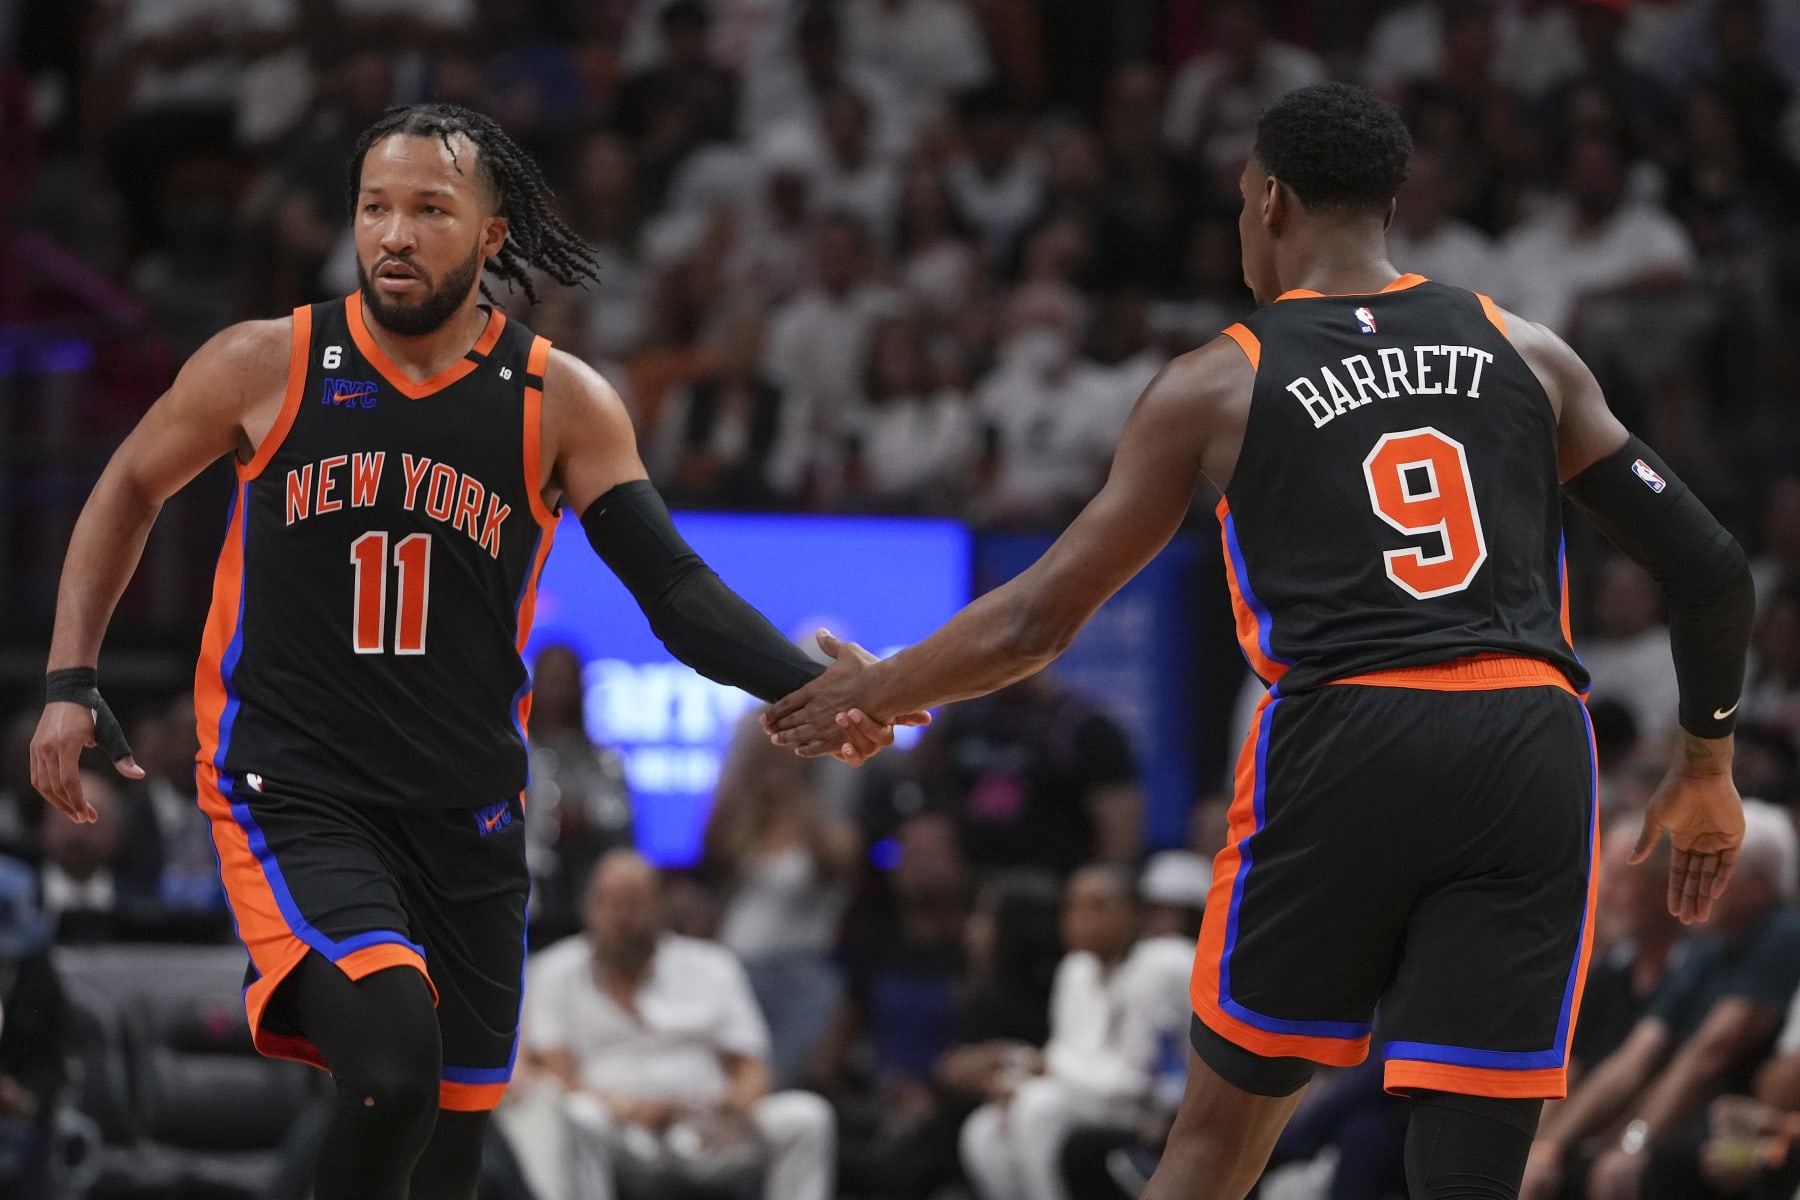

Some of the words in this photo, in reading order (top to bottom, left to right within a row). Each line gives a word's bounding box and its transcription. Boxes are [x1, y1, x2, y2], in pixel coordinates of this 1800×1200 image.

[322, 345, 343, 370] 6
[322, 377, 379, 409] NYC
[1285, 344, 1494, 429] BARRETT
[286, 451, 386, 527] NEW
[402, 453, 512, 560] YORK
[1362, 426, 1488, 600] 9
[350, 530, 432, 655] 11
